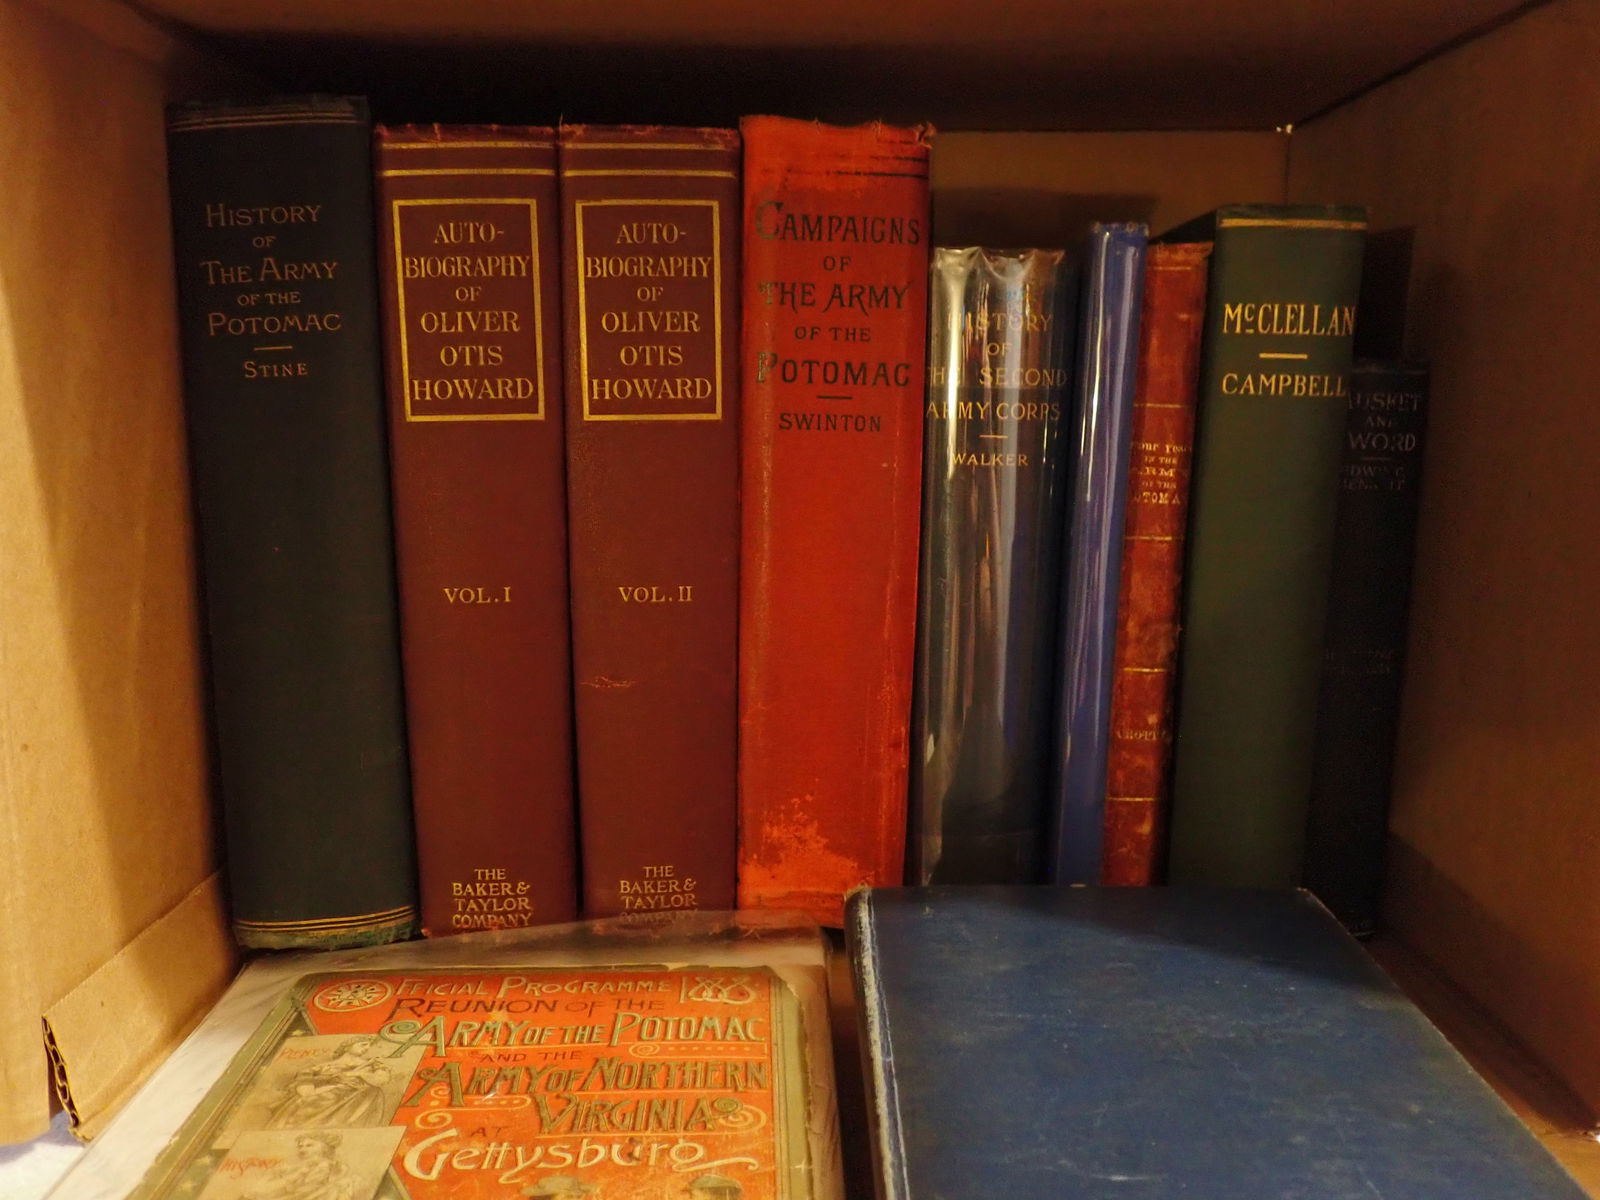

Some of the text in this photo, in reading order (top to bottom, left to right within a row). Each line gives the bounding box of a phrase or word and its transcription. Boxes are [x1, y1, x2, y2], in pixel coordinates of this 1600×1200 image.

[206, 203, 321, 228] HISTORY
[754, 200, 921, 245] CAMPAIGNS
[252, 235, 277, 249] OF
[433, 222, 505, 245] AUTO-
[616, 222, 688, 245] AUTO-
[202, 257, 338, 286] THE ARMY
[404, 255, 530, 279] BIOGRAPHY
[585, 256, 712, 279] BIOGRAPHY
[823, 255, 852, 272] OF
[237, 291, 301, 307] OF THE
[455, 286, 482, 302] OF
[636, 286, 664, 302] OF
[757, 280, 914, 316] THE ARMY
[207, 312, 342, 336] POTOMAC
[420, 311, 521, 334] OLIVER
[601, 311, 700, 334] OLIVER
[794, 326, 871, 342] OF THE
[440, 345, 504, 367] OTIS
[619, 345, 684, 367] OTIS
[987, 342, 1012, 356] OF
[244, 361, 309, 379] STINE
[756, 351, 912, 387] POTOMAC
[413, 377, 534, 402] HOWARD
[592, 377, 713, 401] HOWARD
[1221, 373, 1346, 397] CAMPBELL
[779, 412, 882, 433] SWINTON
[996, 402, 1061, 421] CORPS
[951, 453, 1029, 466] WALKER
[443, 586, 512, 603] VOL. I
[618, 585, 693, 602] VOL. II
[474, 868, 507, 881] THE
[643, 865, 675, 878] THE
[453, 898, 533, 912] TAYLOR
[621, 893, 698, 910] TAYLOR
[452, 912, 532, 929] COMPANY
[497, 976, 673, 998] PROGRAMME
[386, 998, 664, 1021] REUNION OF THE
[379, 1012, 766, 1058] ARMY OF THE POTOMAC
[480, 1051, 581, 1063] AND THE
[402, 1057, 768, 1107] ARMY OF NORTHERN
[533, 1094, 740, 1136] VIRGINIA
[471, 1126, 509, 1137] AT
[403, 1128, 760, 1184] Gettysburg
